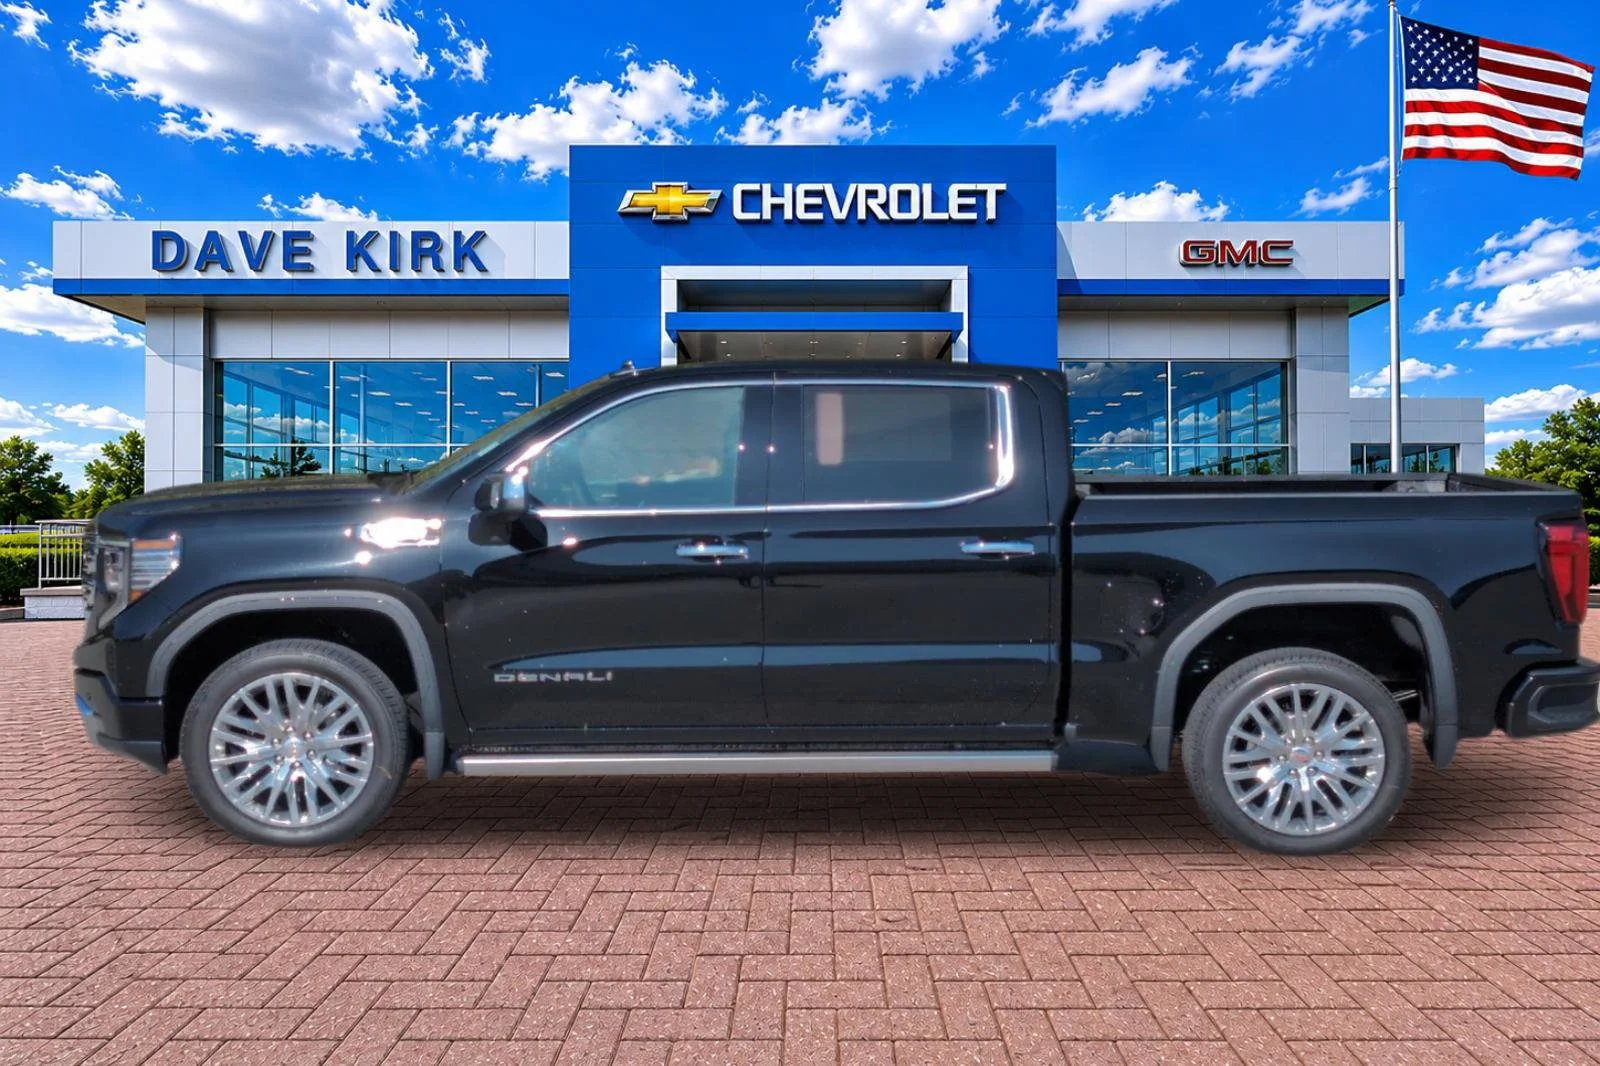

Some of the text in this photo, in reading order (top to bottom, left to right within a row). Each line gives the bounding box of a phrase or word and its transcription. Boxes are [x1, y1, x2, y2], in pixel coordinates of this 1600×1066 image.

[732, 182, 1007, 222] CHEVROLET
[151, 229, 489, 273] DAVE KIRK
[1179, 239, 1295, 268] GMC
[493, 671, 613, 683] DENALI
